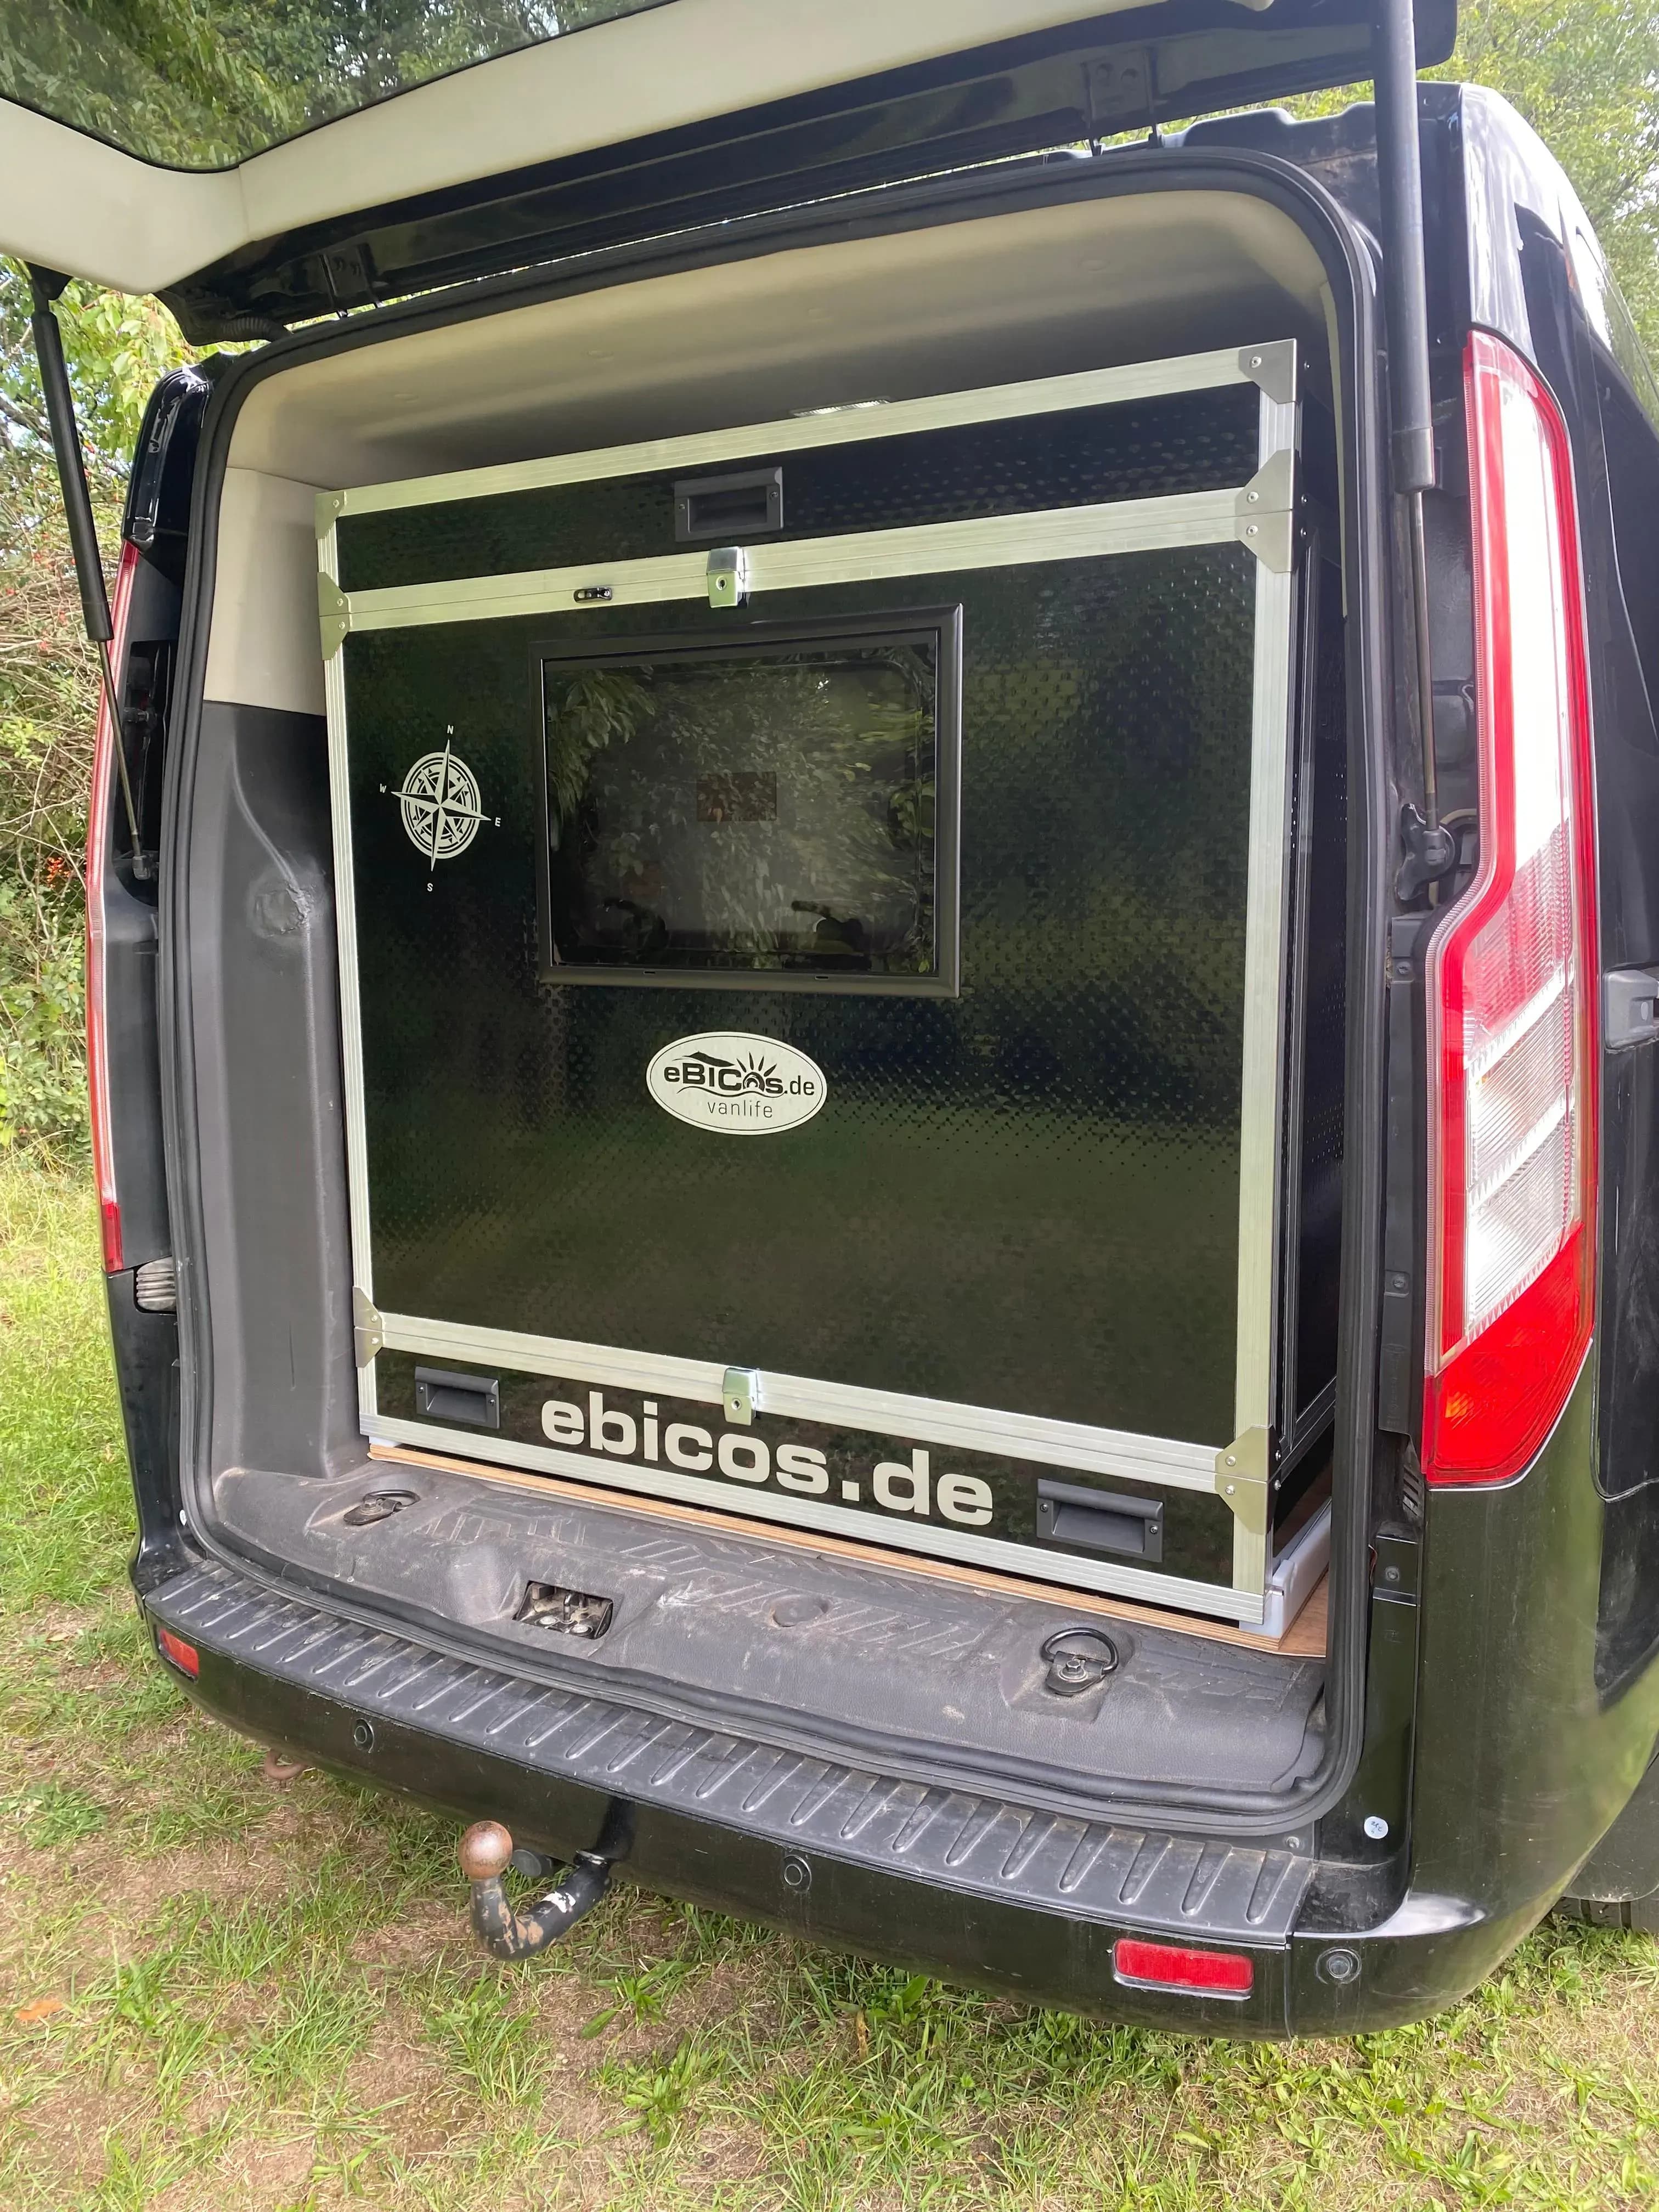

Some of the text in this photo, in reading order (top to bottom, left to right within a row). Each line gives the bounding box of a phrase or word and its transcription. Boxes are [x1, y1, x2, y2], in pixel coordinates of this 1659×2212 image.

[447, 725, 454, 735] N
[380, 783, 387, 793] W
[495, 817, 501, 827] E
[427, 883, 434, 893] S
[707, 1100, 773, 1118] vanlife
[541, 1391, 993, 1526] ebicos.de
